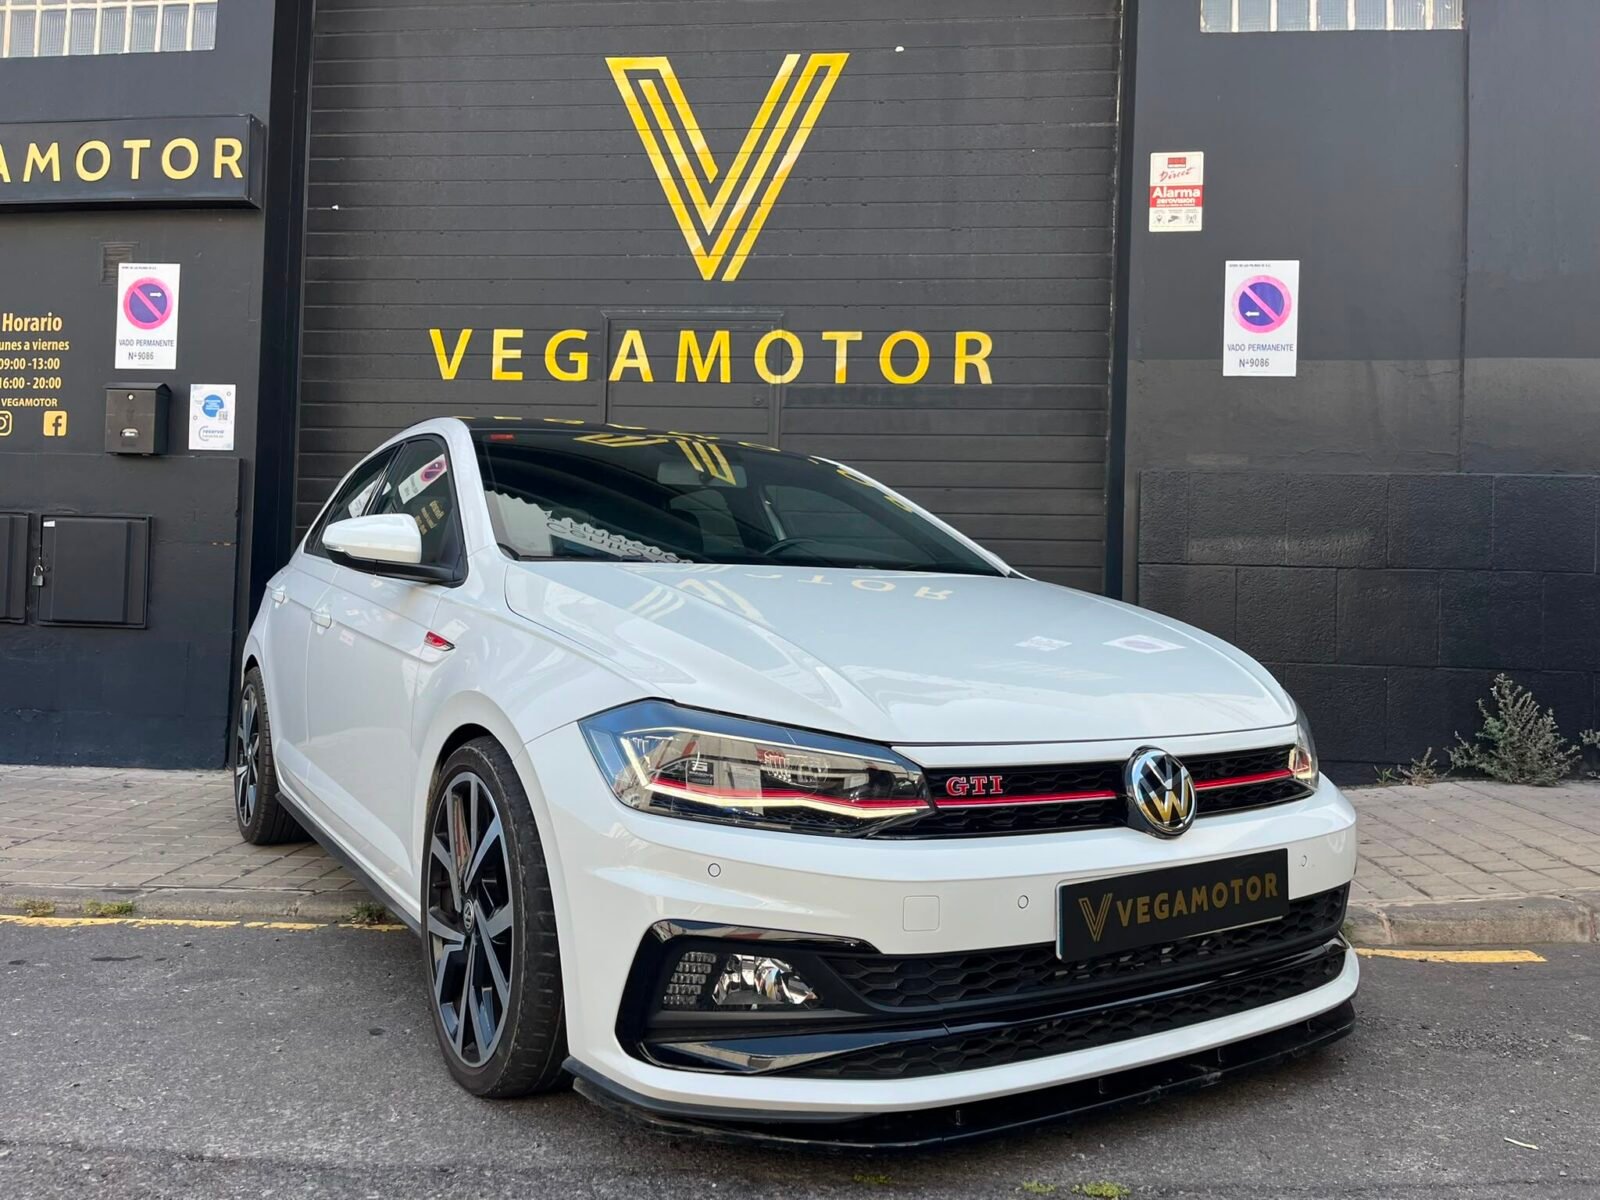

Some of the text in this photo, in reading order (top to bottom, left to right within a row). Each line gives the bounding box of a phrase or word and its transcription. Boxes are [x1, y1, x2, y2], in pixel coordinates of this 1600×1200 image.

[1152, 186, 1201, 199] Alarma
[2, 312, 63, 332] Horario
[23, 341, 30, 351] a
[32, 338, 70, 351] viernes
[119, 339, 175, 348] VADO PERMANENTE
[1227, 343, 1294, 352] VADO PERMANENTE
[429, 328, 993, 386] VEGAMOTOR
[32, 377, 62, 389] 20:00
[1, 397, 58, 407] VEGAMOTOR
[945, 775, 1004, 798] GTI
[1116, 872, 1279, 928] VEGAMOTOR
